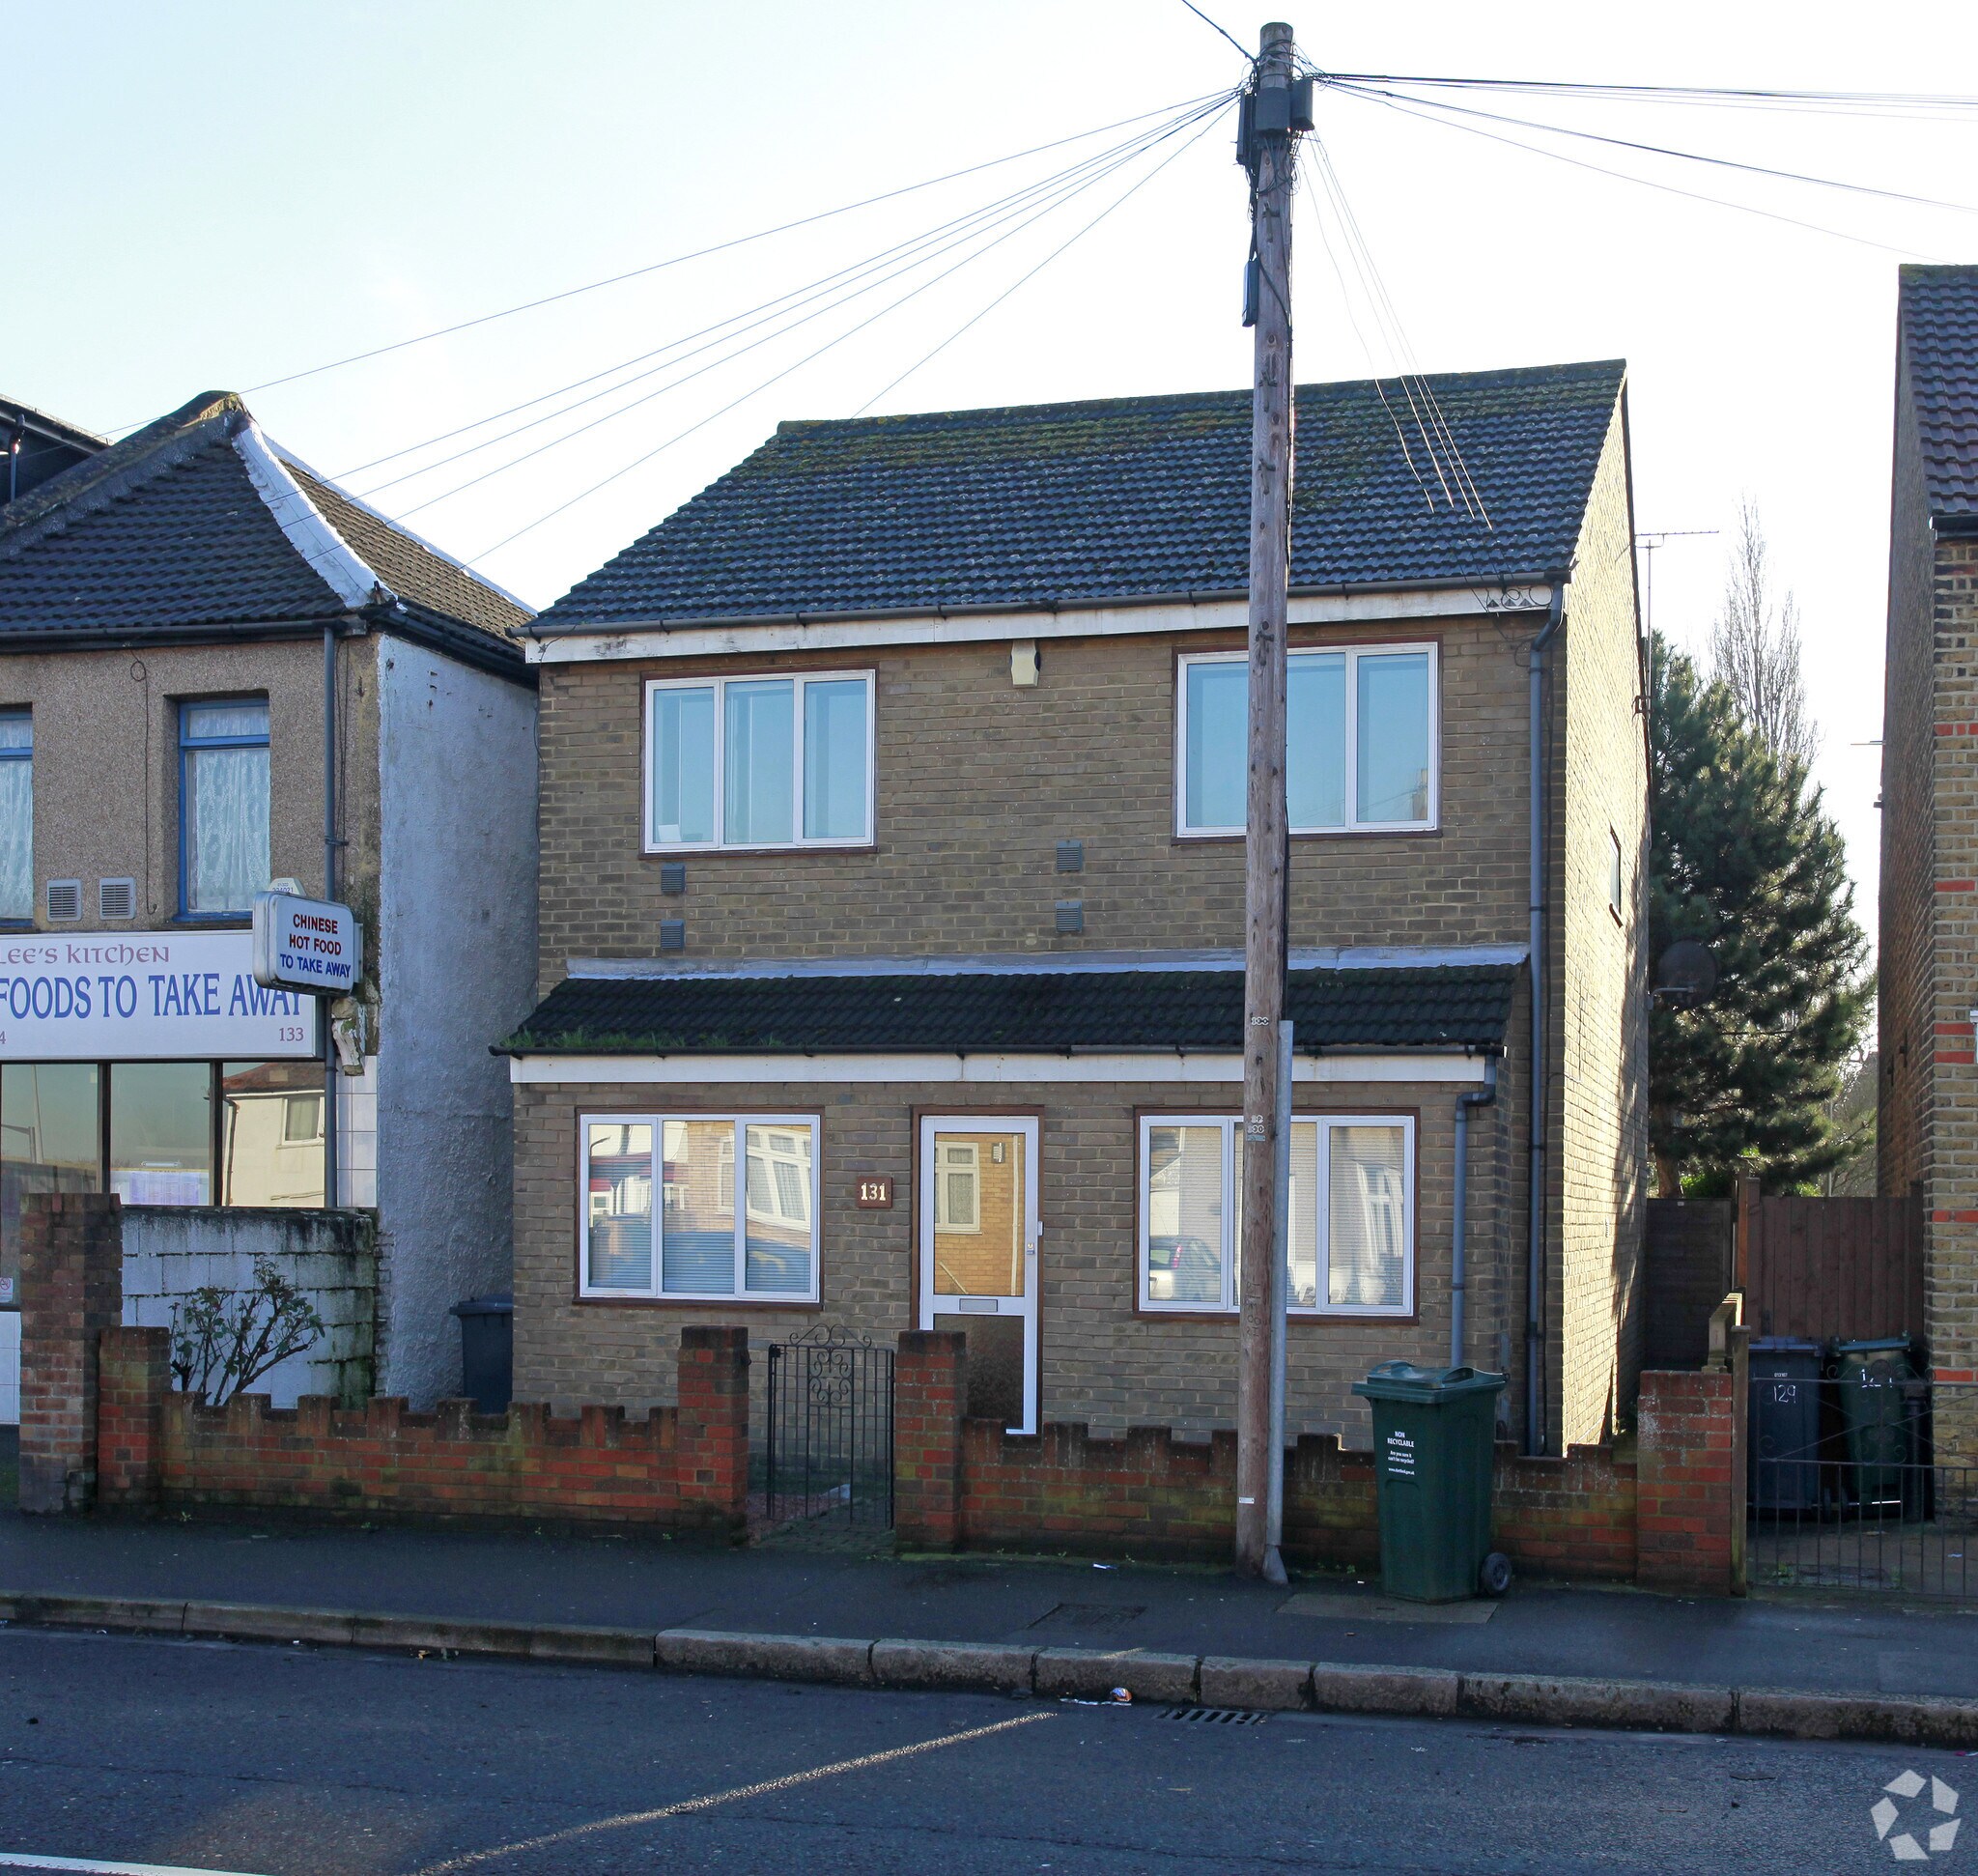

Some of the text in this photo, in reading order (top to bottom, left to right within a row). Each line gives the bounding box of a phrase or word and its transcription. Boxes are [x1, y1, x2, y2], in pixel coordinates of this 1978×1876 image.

[293, 914, 338, 934] CHINESE
[289, 933, 342, 955] HOT FOOD
[0, 947, 58, 964] EE'S
[280, 953, 352, 979] TO TAKE AWAY
[98, 975, 137, 1018] TO
[148, 973, 221, 1016] TAKE
[279, 1027, 304, 1041] 133
[861, 1182, 887, 1201] 131
[1773, 1384, 1795, 1404] 129
[1387, 1437, 1415, 1447] RECYCLABLE
